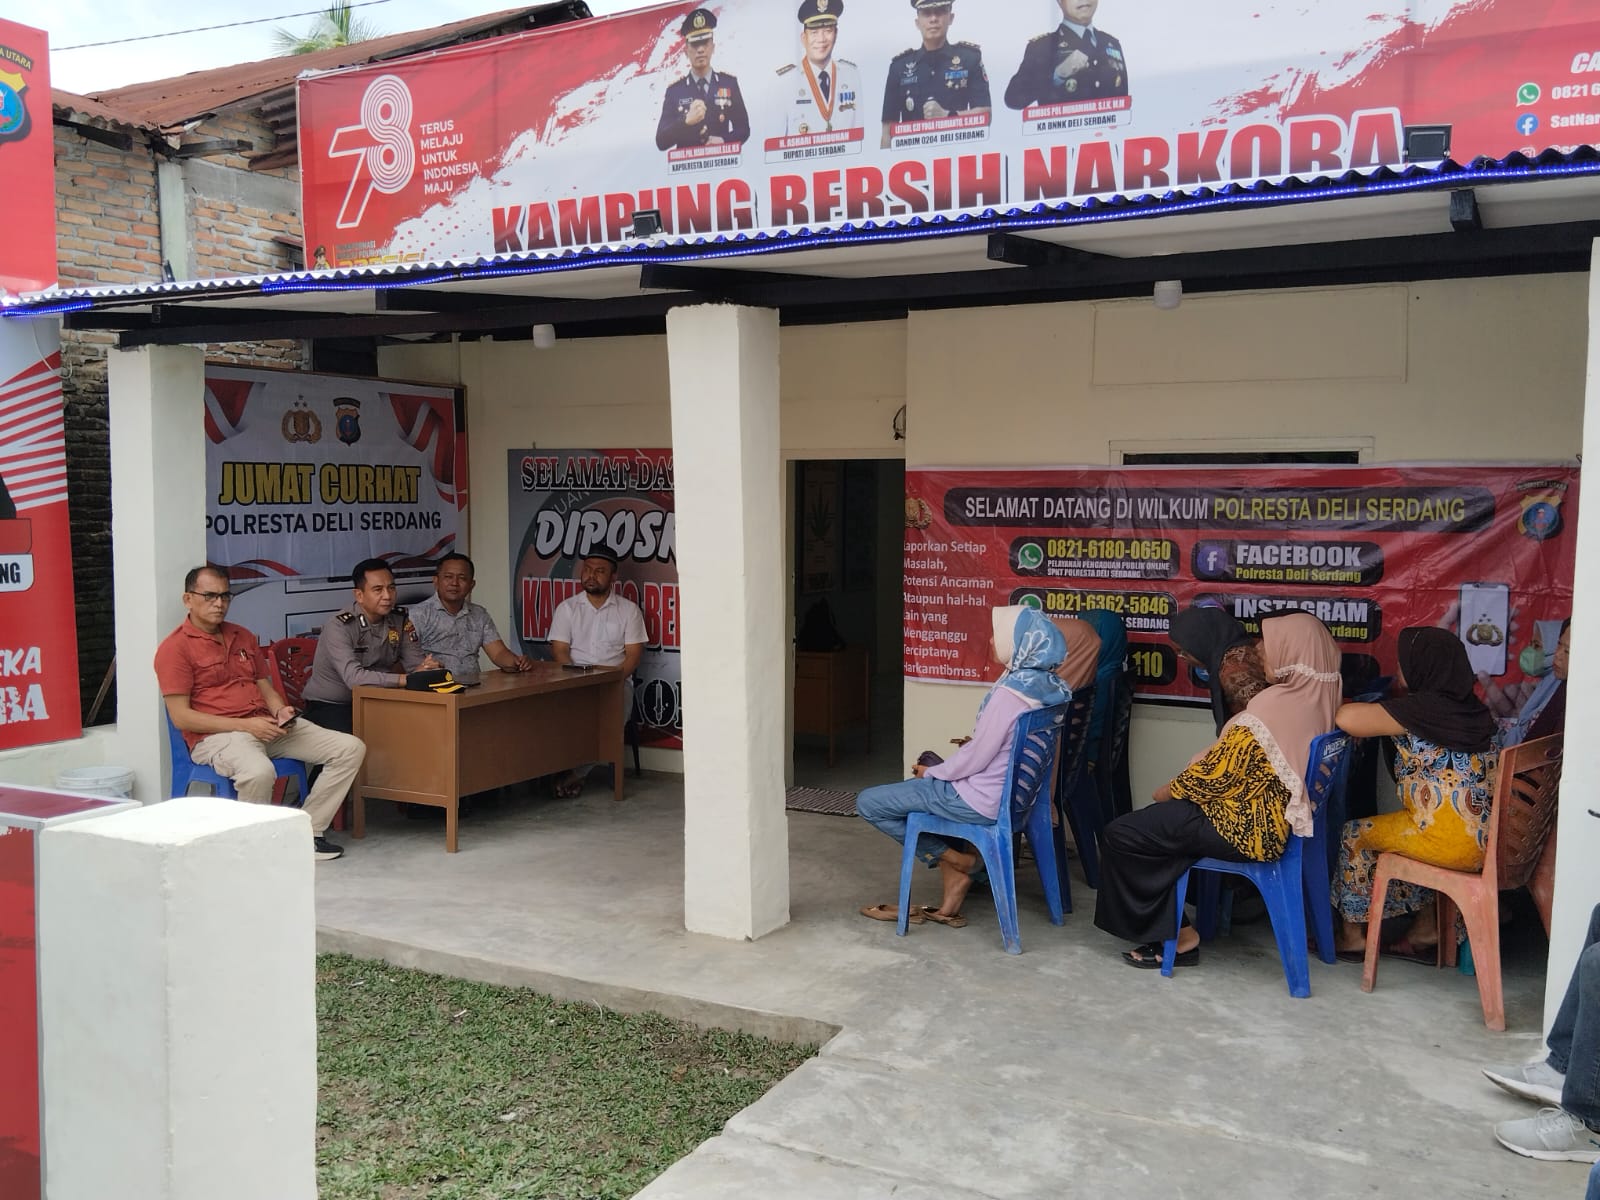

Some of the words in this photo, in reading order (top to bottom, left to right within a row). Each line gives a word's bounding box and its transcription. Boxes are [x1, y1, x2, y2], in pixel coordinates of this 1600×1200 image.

[6, 49, 31, 70] UTARA
[1551, 83, 1588, 100] 0821
[419, 120, 454, 135] TERUS
[1037, 122, 1046, 131] KA
[1068, 118, 1083, 128] DELI
[1084, 114, 1116, 126] SERDANG
[420, 133, 463, 150] MELAJU
[895, 137, 920, 147] DANDIM
[921, 135, 938, 145] 0204
[940, 133, 954, 143] DELI
[955, 129, 985, 140] SERDANG
[328, 74, 416, 229] 78
[421, 149, 458, 165] UNTUK
[783, 149, 804, 160] BUPATI
[805, 148, 817, 158] DELI
[818, 144, 846, 156] SERDANG
[423, 161, 480, 180] INDONESIA
[703, 159, 714, 169] DELI
[714, 156, 738, 168] SERDANG
[424, 181, 454, 195] MAJU
[491, 178, 753, 254] KAMPUNG
[769, 152, 1001, 227] BERSIH
[1023, 112, 1400, 201] NARKOBA
[520, 456, 630, 491] SELAMAT
[219, 462, 315, 506] JUMAT
[320, 462, 421, 505] CURHAT
[965, 496, 1039, 518] SELAMAT
[1043, 497, 1111, 519] DATANG
[1116, 498, 1132, 519] DI
[1137, 498, 1209, 519] WILKUM
[1213, 498, 1312, 520] POLRESTA
[1317, 498, 1360, 521] DELI
[1366, 498, 1465, 522] SERDANG
[312, 512, 353, 533] DELI
[360, 511, 442, 531] SERDANG
[951, 541, 986, 555] Setiap
[1047, 539, 1171, 561] 0821-6180-0650
[1236, 544, 1361, 567] FACEBOOK
[1064, 569, 1095, 577] POLRESTA
[1096, 569, 1110, 577] DELI
[1110, 570, 1141, 578] SERDANG
[1146, 562, 1170, 571] ONLINE
[1235, 567, 1283, 580] Polresta
[1285, 568, 1309, 580] Deli
[1311, 569, 1361, 583] Serdang
[940, 576, 994, 589] Ancaman
[946, 593, 986, 607] hal-hal
[1046, 592, 1169, 616] 0821-6362-5846
[922, 613, 948, 625] yang
[1125, 616, 1170, 630] SERDANG
[1132, 651, 1163, 678] 110
